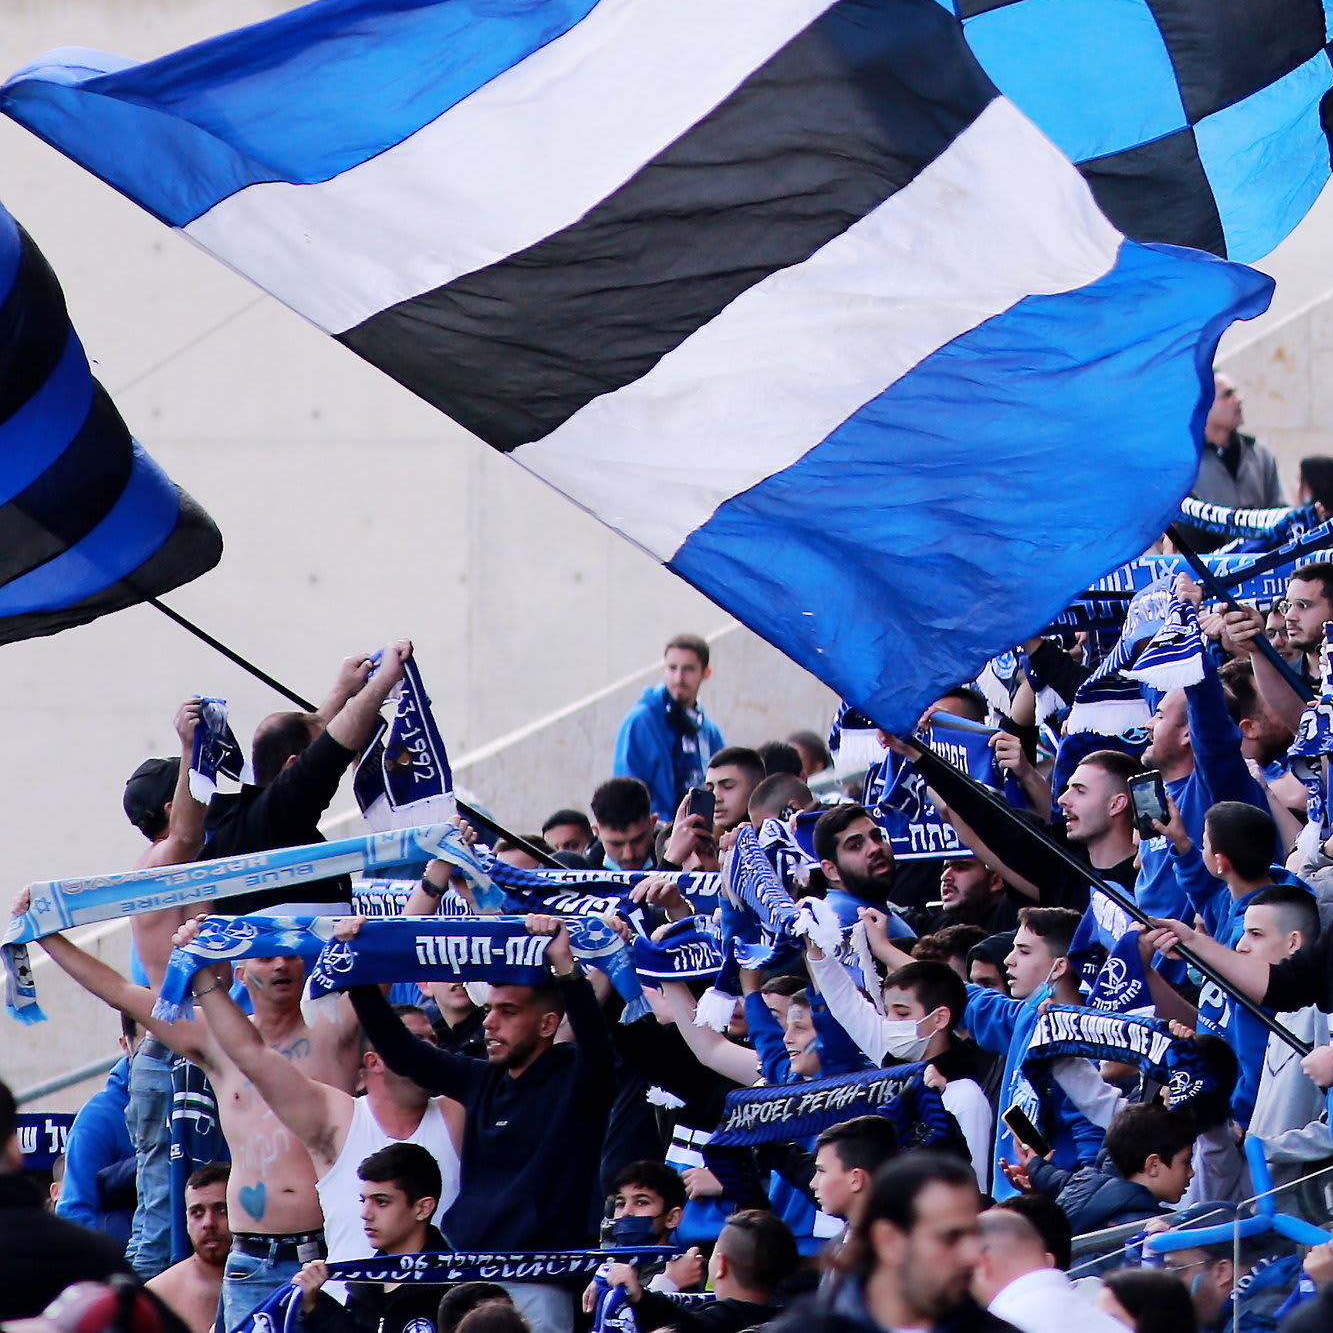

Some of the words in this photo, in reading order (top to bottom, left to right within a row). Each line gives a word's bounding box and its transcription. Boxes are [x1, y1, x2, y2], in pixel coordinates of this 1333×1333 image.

[246, 862, 315, 893] BLUE
[119, 880, 218, 917] EMPIRE
[415, 934, 552, 976] תח-תקוה
[723, 1097, 796, 1133] HAPOEL
[797, 1077, 914, 1117] PETAH-TIKV
